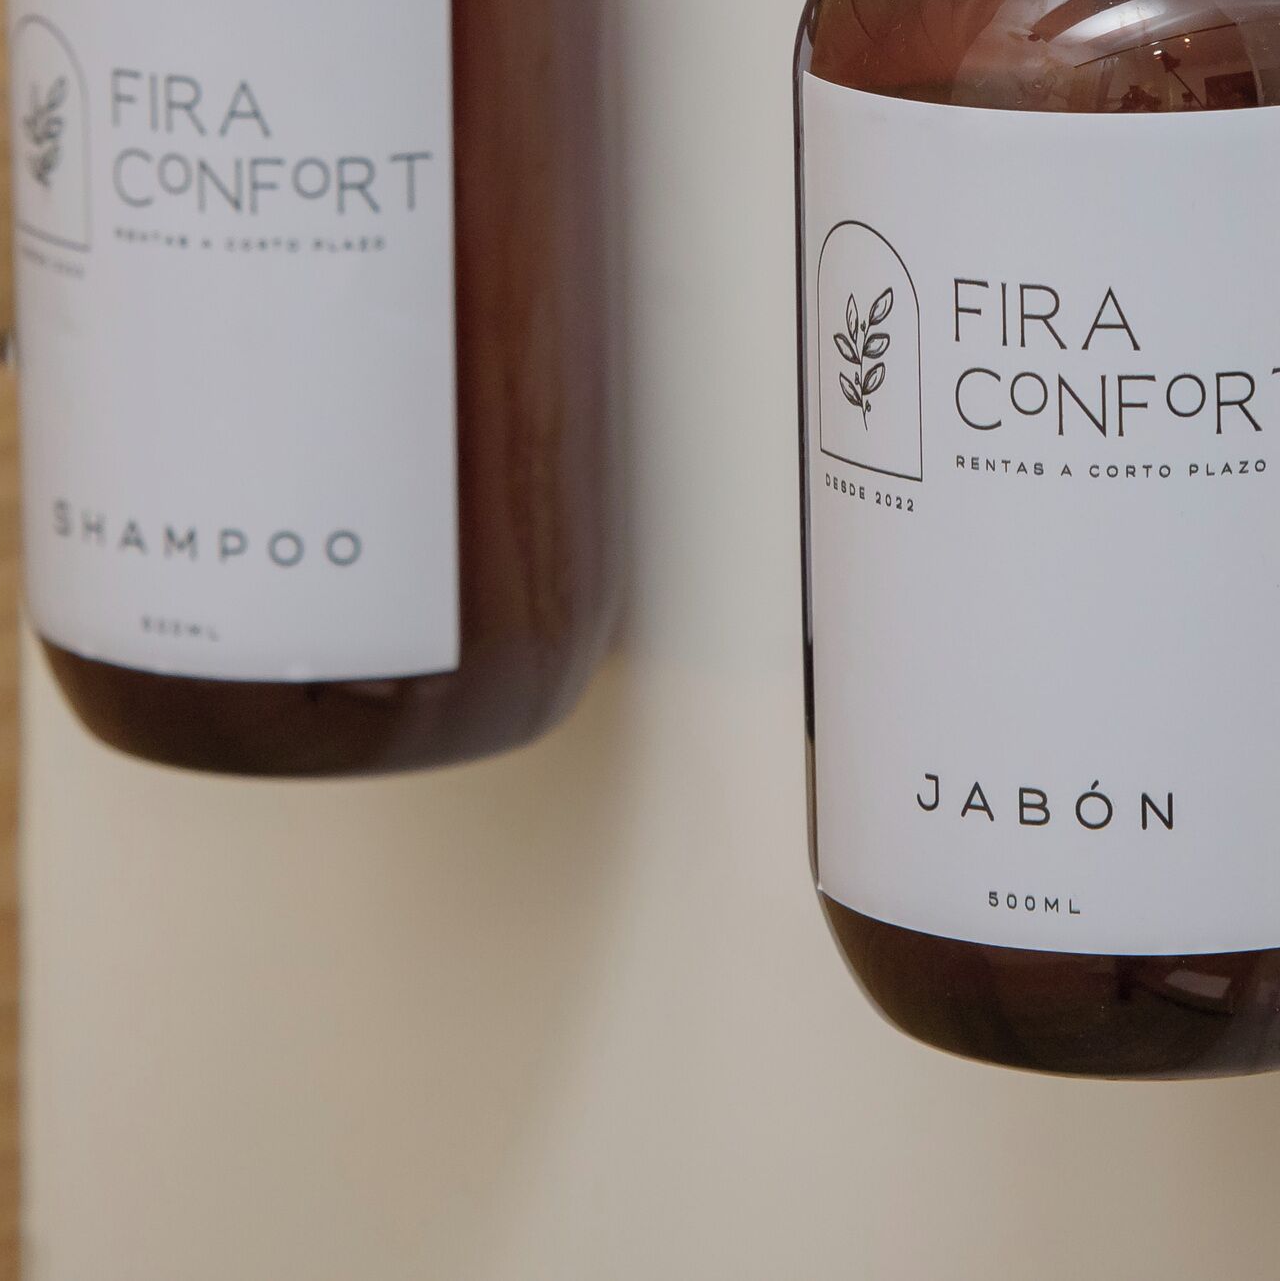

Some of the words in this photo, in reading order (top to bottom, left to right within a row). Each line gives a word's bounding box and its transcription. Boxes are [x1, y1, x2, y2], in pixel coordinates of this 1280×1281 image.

[111, 68, 271, 138] FIRA
[954, 278, 1141, 351] FIRA
[825, 473, 866, 500] DESDE
[875, 491, 914, 512] 2022
[956, 455, 1045, 477] RENTAS
[1060, 463, 1073, 478] A
[1088, 463, 1172, 479] CORTO
[1188, 459, 1267, 478] PLAZO
[54, 499, 363, 568] SHAMPOO
[917, 773, 1174, 830] JABÓN
[988, 890, 1081, 914] 500ML
